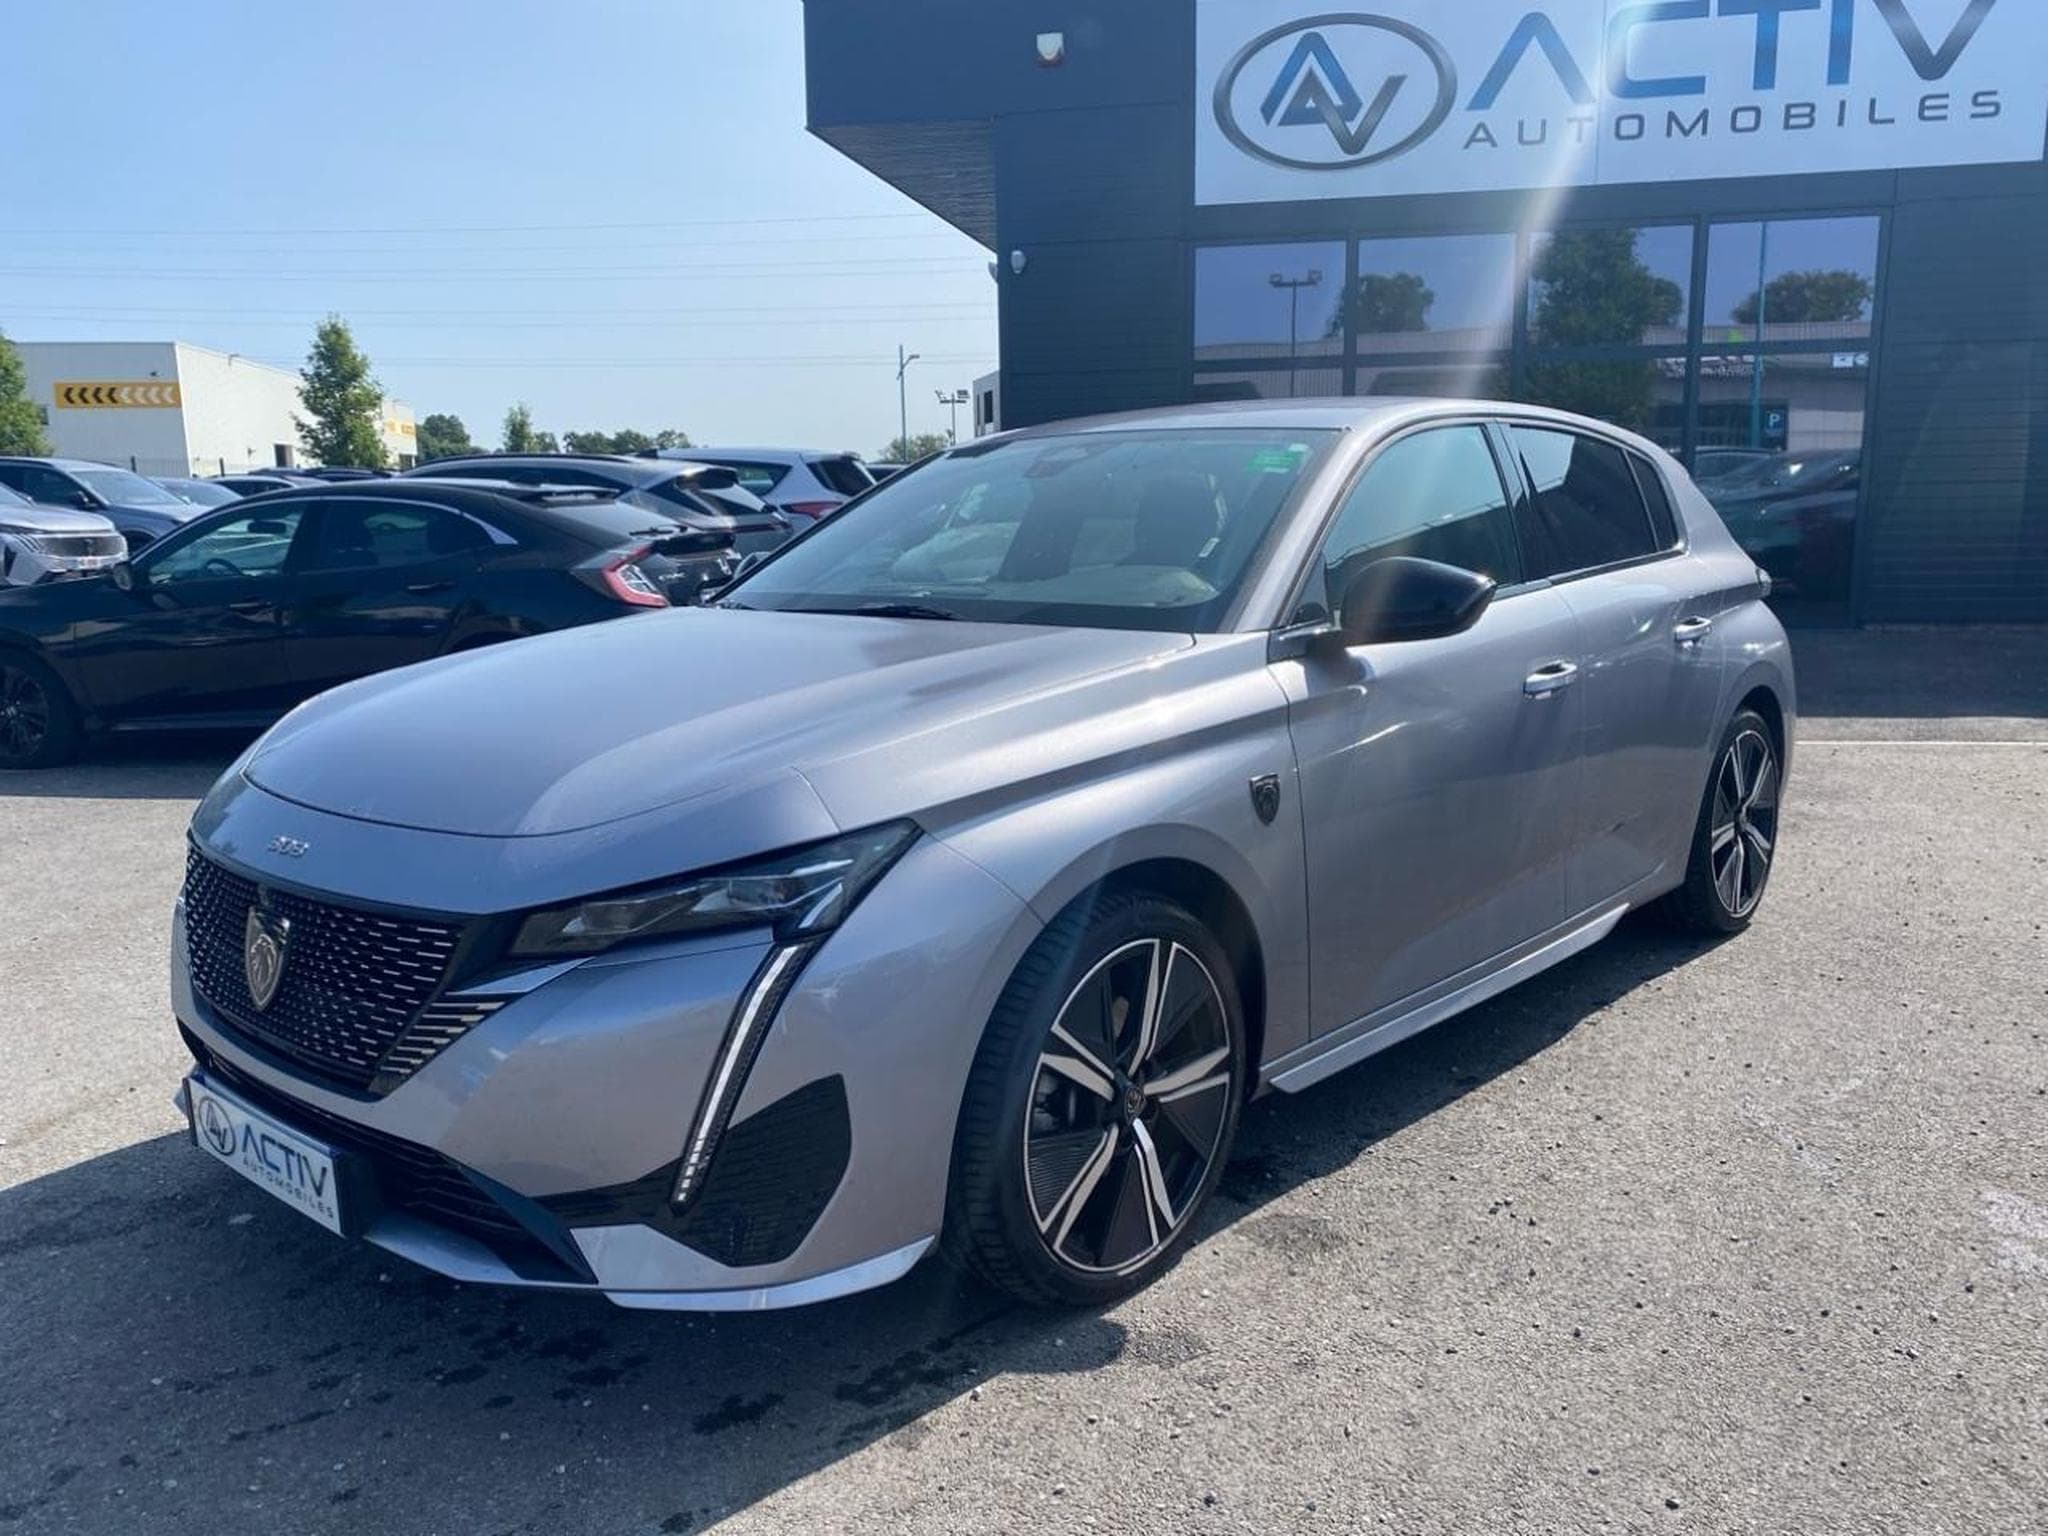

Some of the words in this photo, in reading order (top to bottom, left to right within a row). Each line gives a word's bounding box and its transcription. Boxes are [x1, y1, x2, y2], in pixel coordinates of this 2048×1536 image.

[1466, 0, 1997, 112] ACTIV
[1464, 90, 2001, 150] AUTOMOBILES
[242, 1123, 328, 1198] ACTIV
